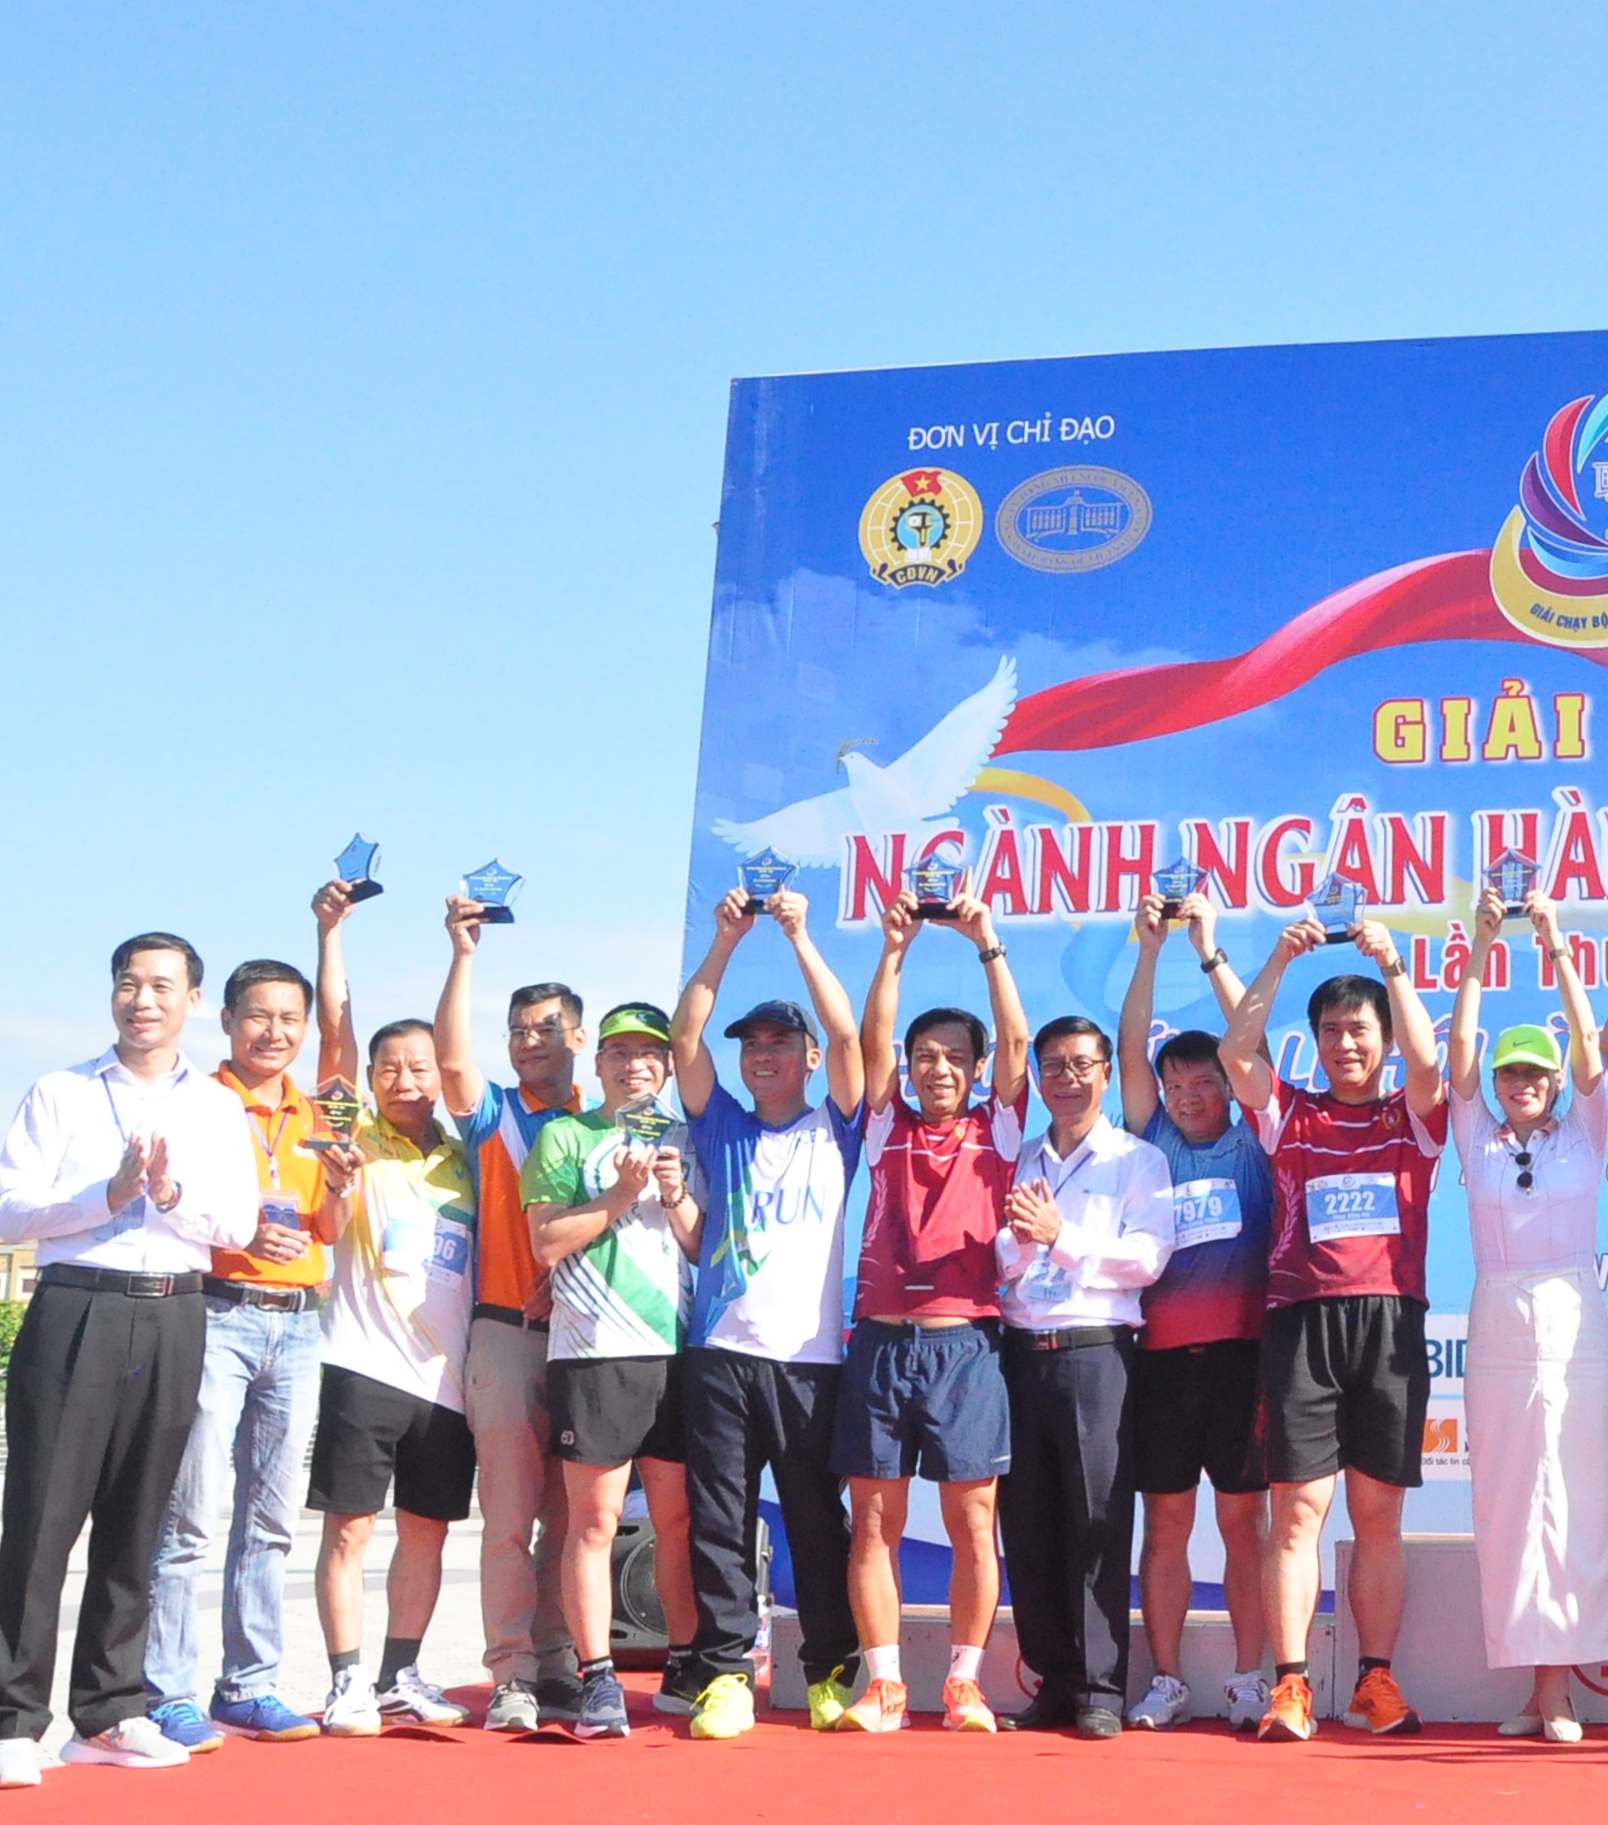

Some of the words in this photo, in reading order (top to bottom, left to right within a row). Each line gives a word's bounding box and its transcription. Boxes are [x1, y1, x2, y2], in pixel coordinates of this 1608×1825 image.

[908, 425, 965, 450] ĐƠN
[972, 422, 999, 450] VỊ
[1007, 411, 1051, 444] CHỈ
[1059, 415, 1115, 445] ĐẠO
[1529, 602, 1554, 623] GIẢI
[1556, 614, 1587, 632] CHẠY
[1592, 611, 1608, 629] BỘ
[1373, 678, 1585, 763] GIẢI
[1187, 795, 1447, 909] NGÂN
[1413, 922, 1509, 989] Lần
[750, 1184, 826, 1232] RUN
[1174, 1196, 1223, 1226] 7979
[1324, 1191, 1376, 1216] 2222
